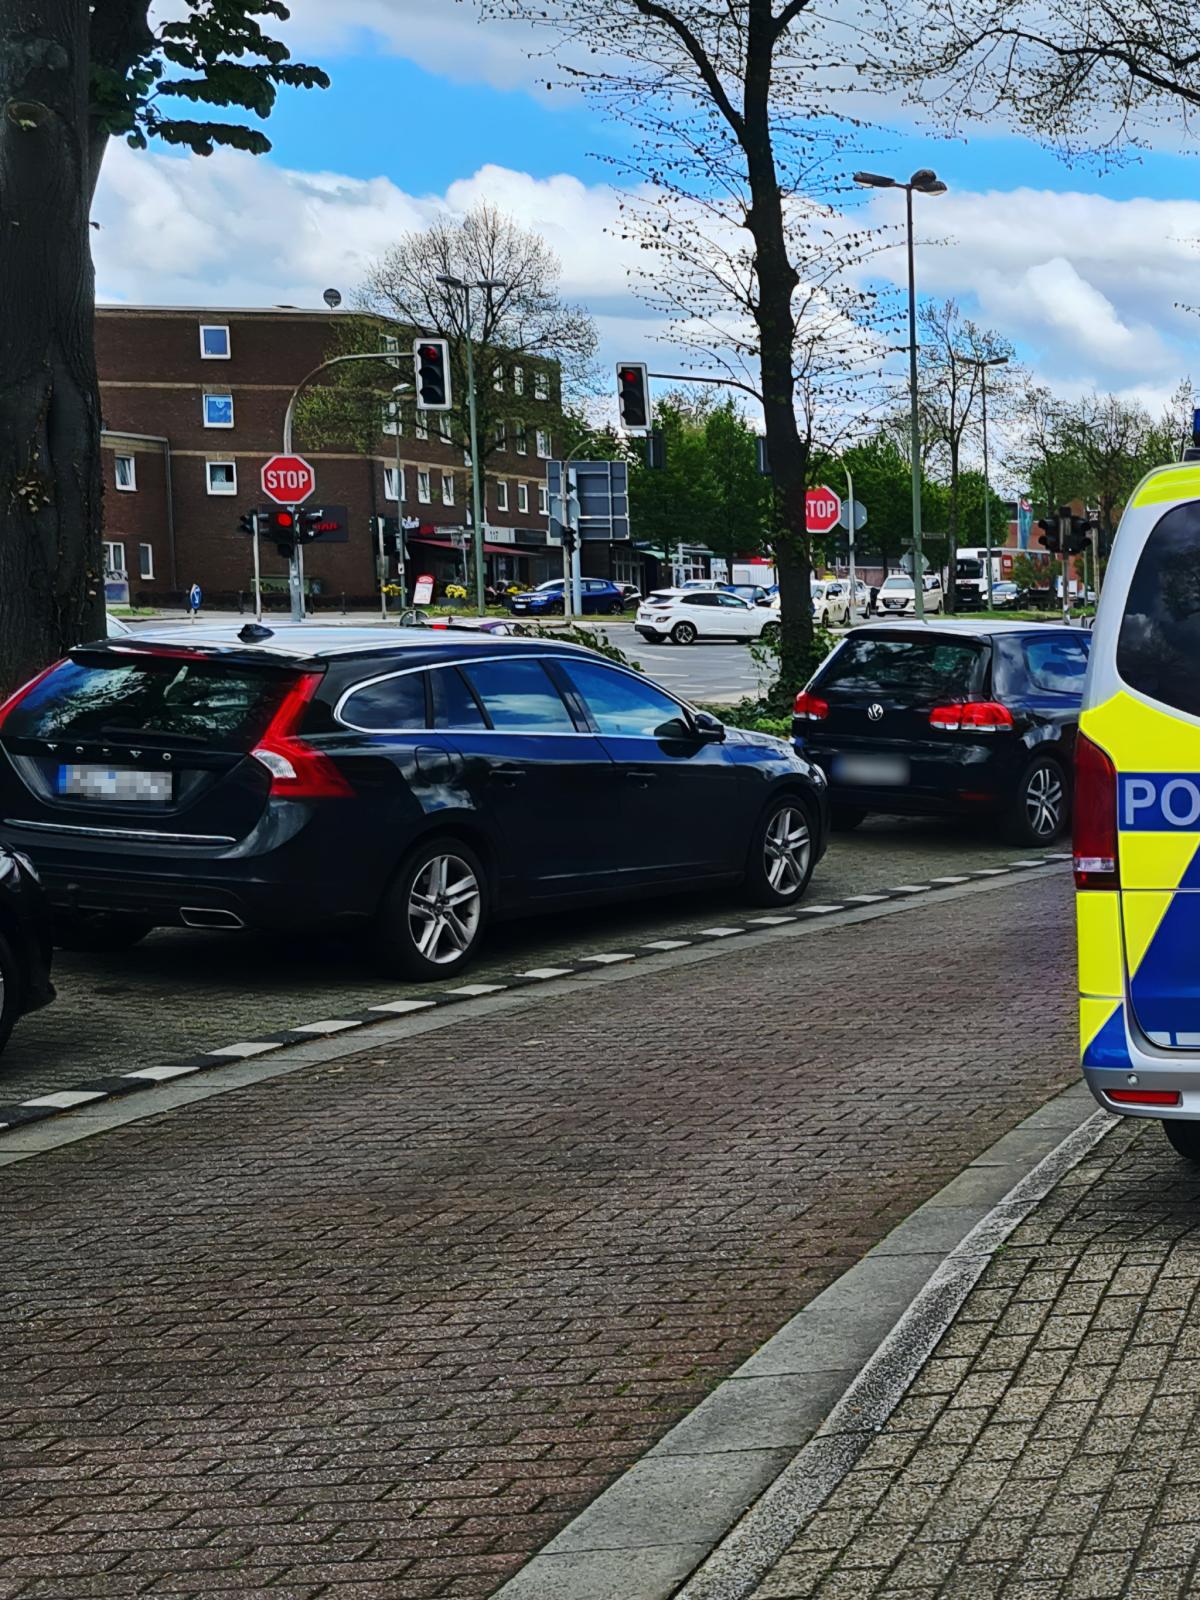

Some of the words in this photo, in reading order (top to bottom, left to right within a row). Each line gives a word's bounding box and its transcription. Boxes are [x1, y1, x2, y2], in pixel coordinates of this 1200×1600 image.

[267, 470, 308, 489] STOP
[806, 501, 836, 518] TOP
[47, 743, 172, 761] VOLVO
